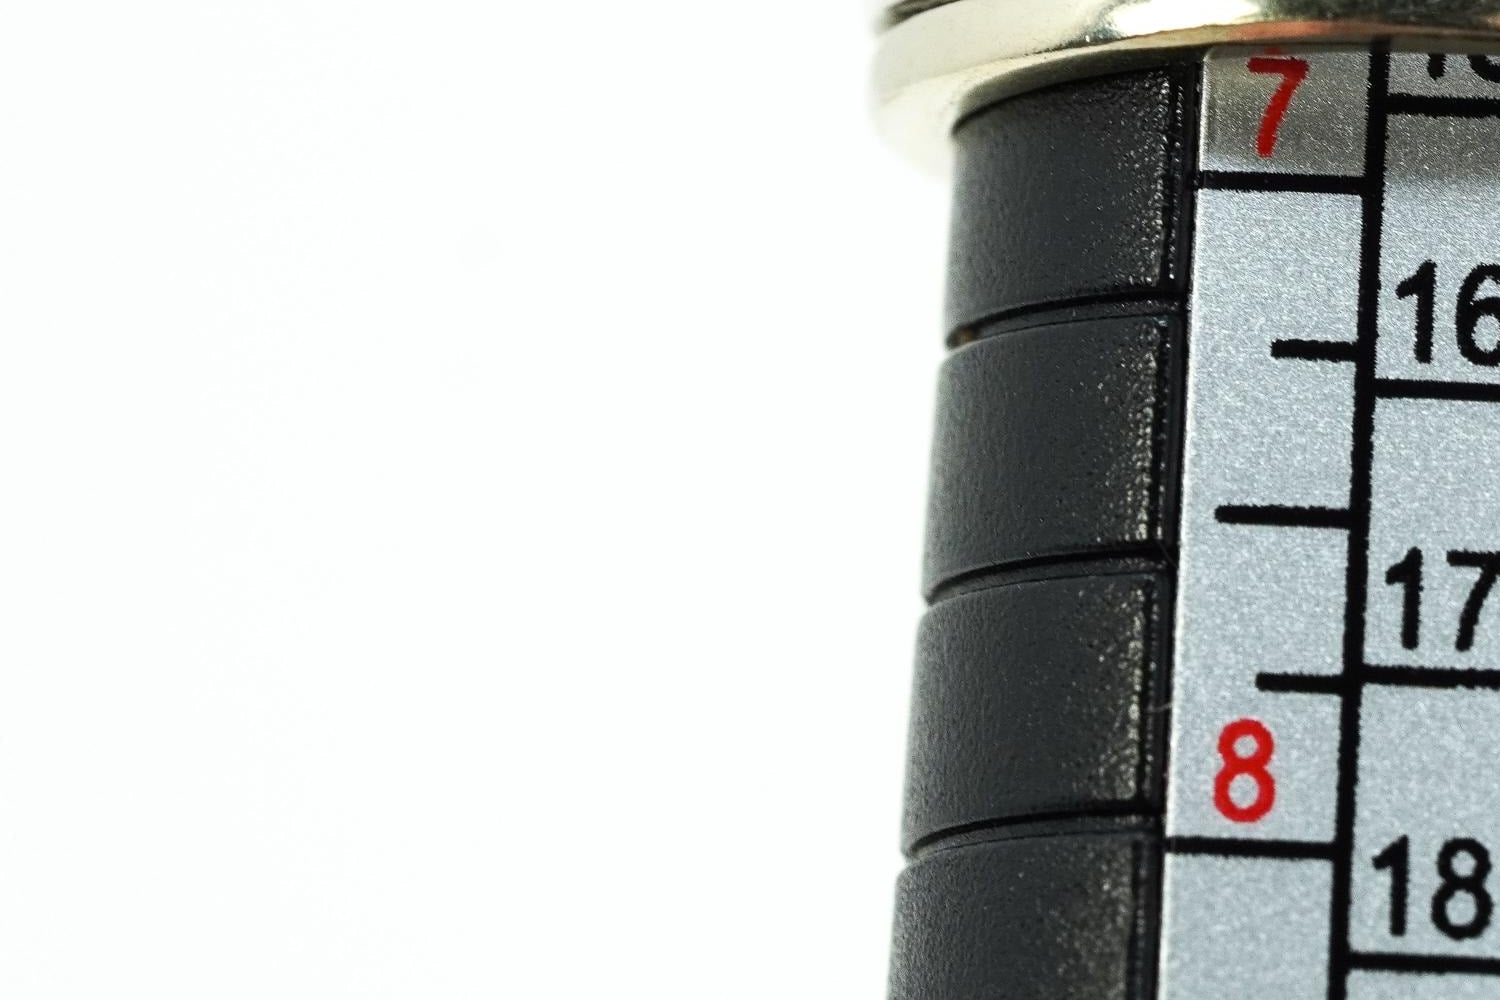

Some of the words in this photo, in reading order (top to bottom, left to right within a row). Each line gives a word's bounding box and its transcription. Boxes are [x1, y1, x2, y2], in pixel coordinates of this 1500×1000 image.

[1246, 57, 1310, 159] 7
[1213, 718, 1276, 823] 8
[1371, 834, 1495, 941] 18
